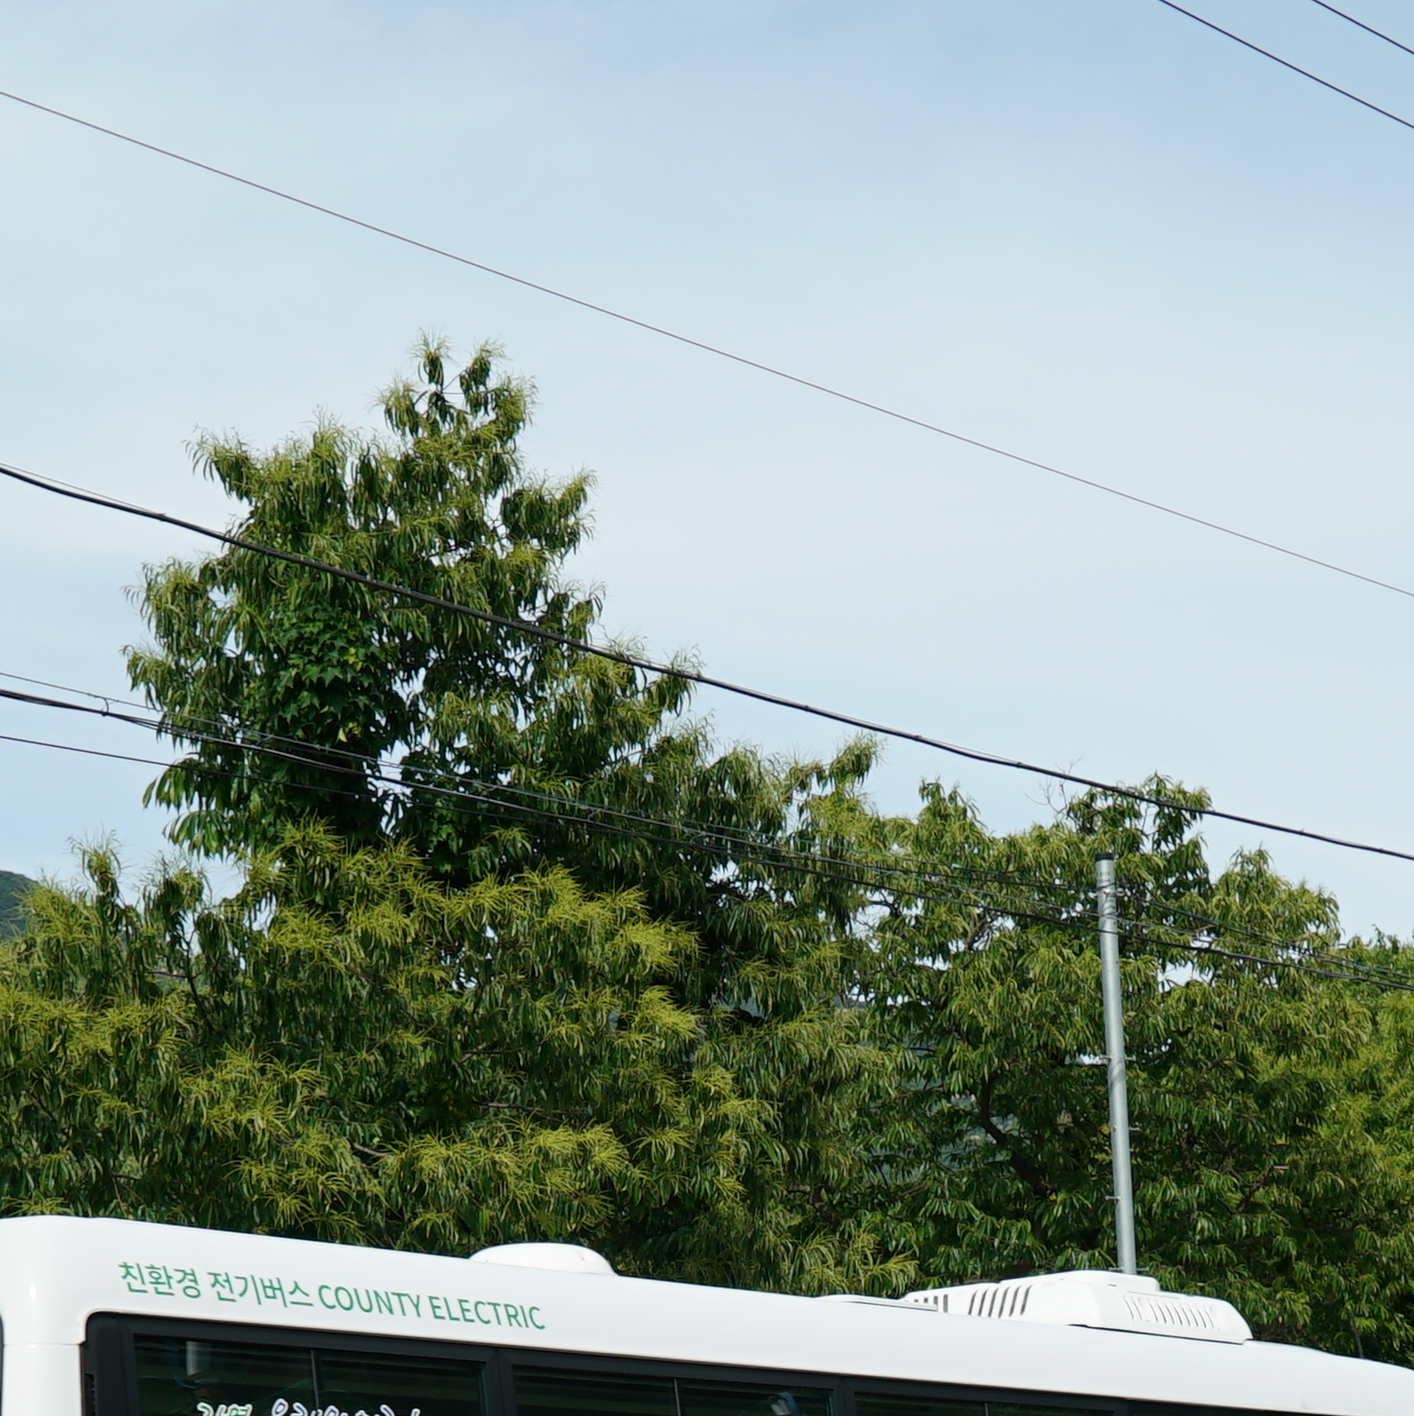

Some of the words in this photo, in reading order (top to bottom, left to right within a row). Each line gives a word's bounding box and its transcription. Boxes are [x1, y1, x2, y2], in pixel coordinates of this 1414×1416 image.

[118, 1261, 202, 1299] 친환경
[207, 1271, 314, 1308] 전기버스
[318, 1284, 422, 1319] COUNTY
[427, 1296, 546, 1331] ELECTRIC
